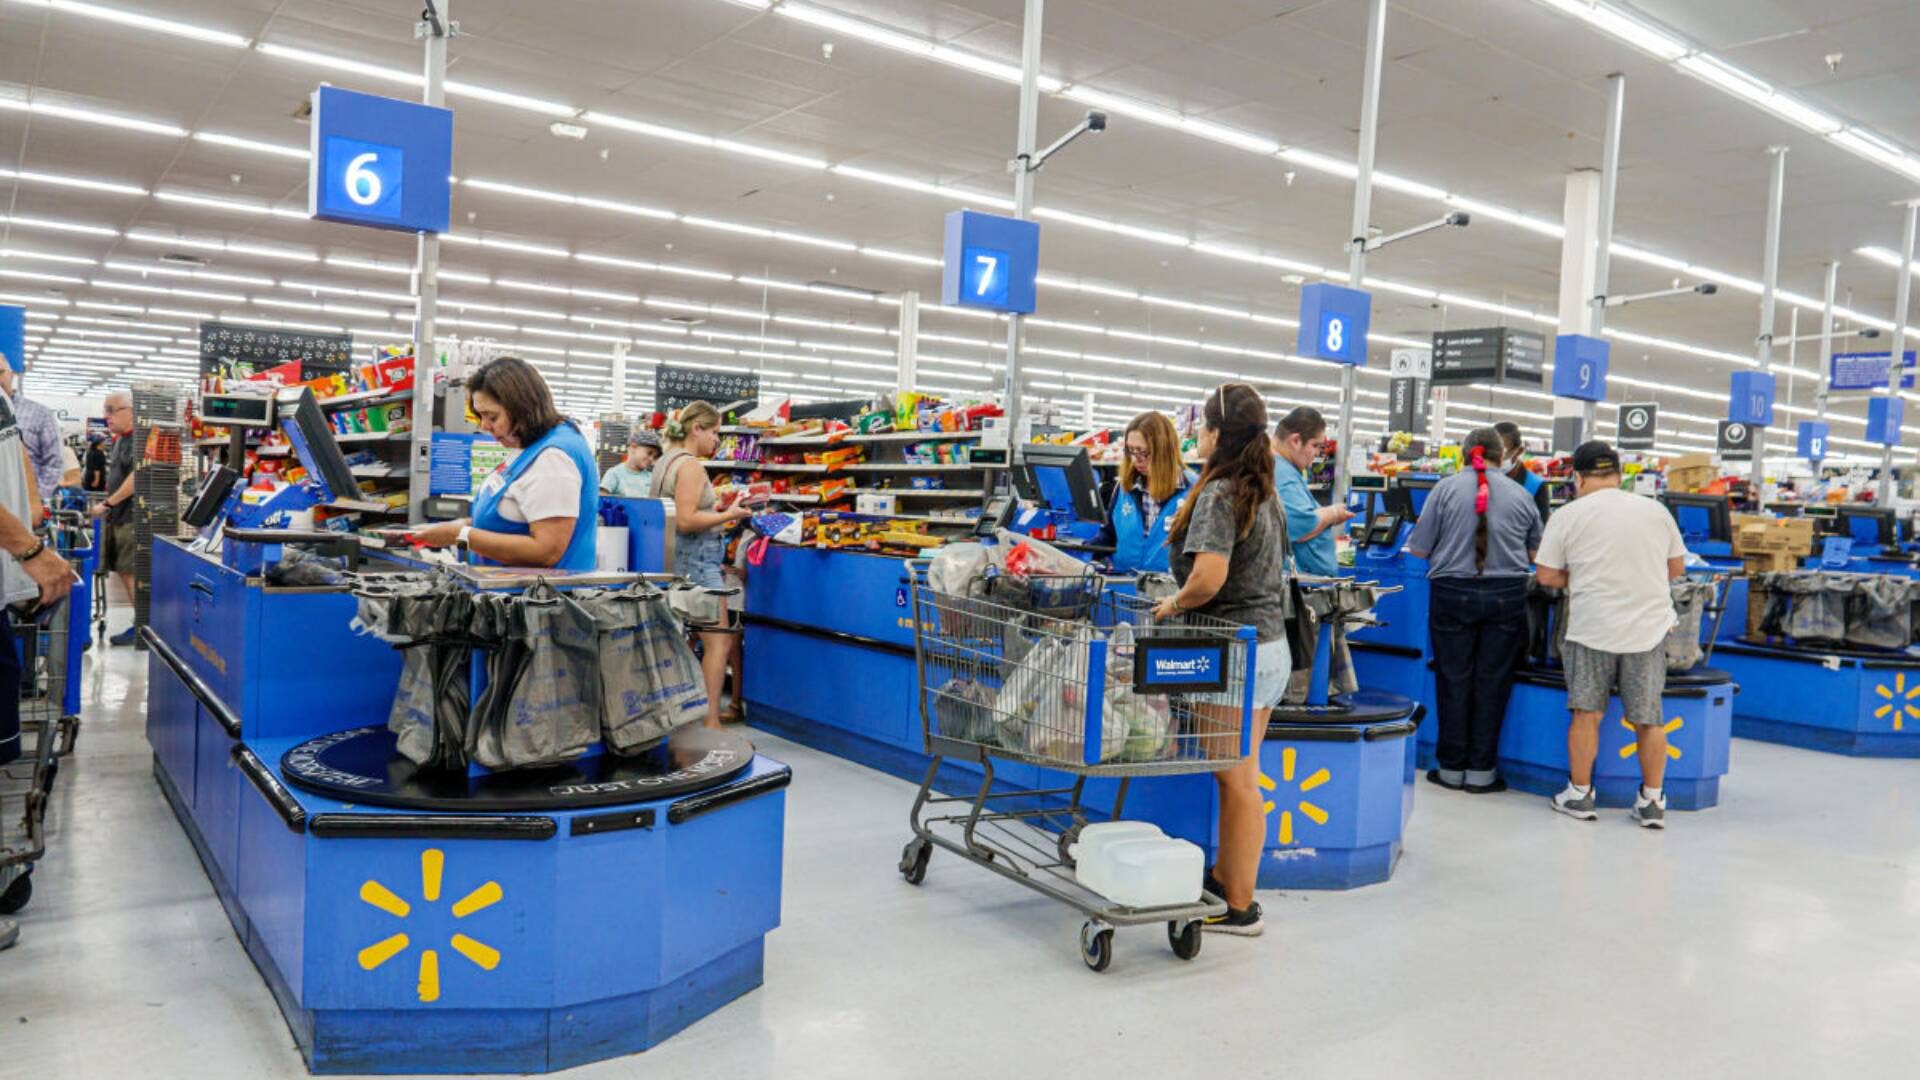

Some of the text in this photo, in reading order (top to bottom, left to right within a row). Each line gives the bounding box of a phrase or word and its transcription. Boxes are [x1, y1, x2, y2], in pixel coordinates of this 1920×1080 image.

[345, 152, 382, 206] 6
[976, 255, 998, 296] 7
[1327, 318, 1343, 352] 8
[1580, 363, 1590, 389] 9
[1751, 395, 1765, 417] 10
[1156, 659, 1196, 670] Walmart
[560, 781, 632, 795] JUST
